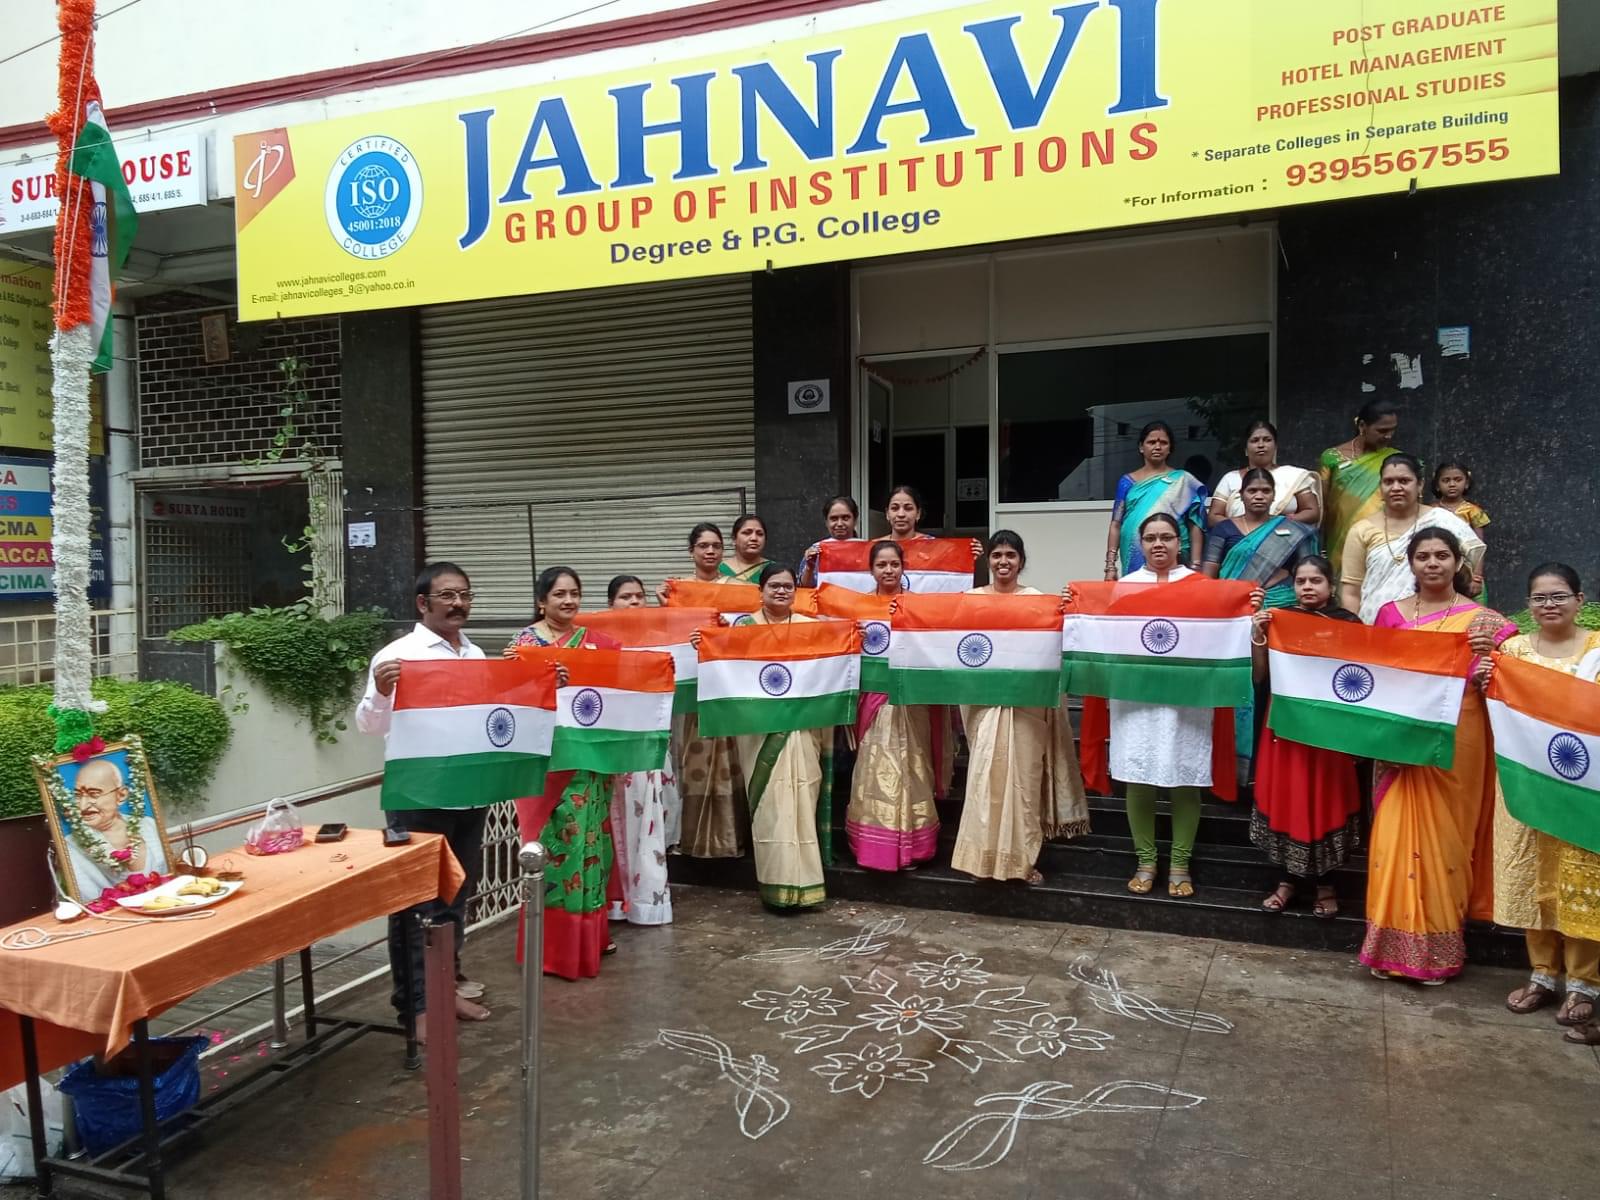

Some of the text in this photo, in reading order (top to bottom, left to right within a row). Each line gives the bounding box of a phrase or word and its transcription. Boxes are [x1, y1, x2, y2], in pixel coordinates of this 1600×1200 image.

[1333, 5, 1506, 46] POST GRADUATE
[1281, 38, 1507, 86] HOTEL MANAGEMENT
[1256, 71, 1507, 122] PROFESSIONAL STUDIES
[459, 0, 1169, 249] JAHNAVI
[1204, 144, 1271, 162] Separate
[1276, 133, 1341, 152] Colleges
[1346, 128, 1361, 142] in
[1366, 119, 1437, 139] Separate
[1442, 111, 1509, 129] Building
[11, 150, 191, 203] SUR OUSE
[341, 141, 409, 167] CERTIFIED
[1161, 183, 1255, 204] Information
[1286, 137, 1510, 187] 9395567555
[349, 176, 400, 207] ISO
[505, 122, 1158, 243] GROUP OF INSTITUTIONS
[343, 231, 407, 257] COLLEGE
[348, 216, 401, 232] 45001:2018
[610, 207, 941, 265] Degree & P.G. College
[276, 268, 387, 288] www.jahnavicolleges.com
[281, 279, 415, 302] jahnavicolleges_9@yahoo.co.in
